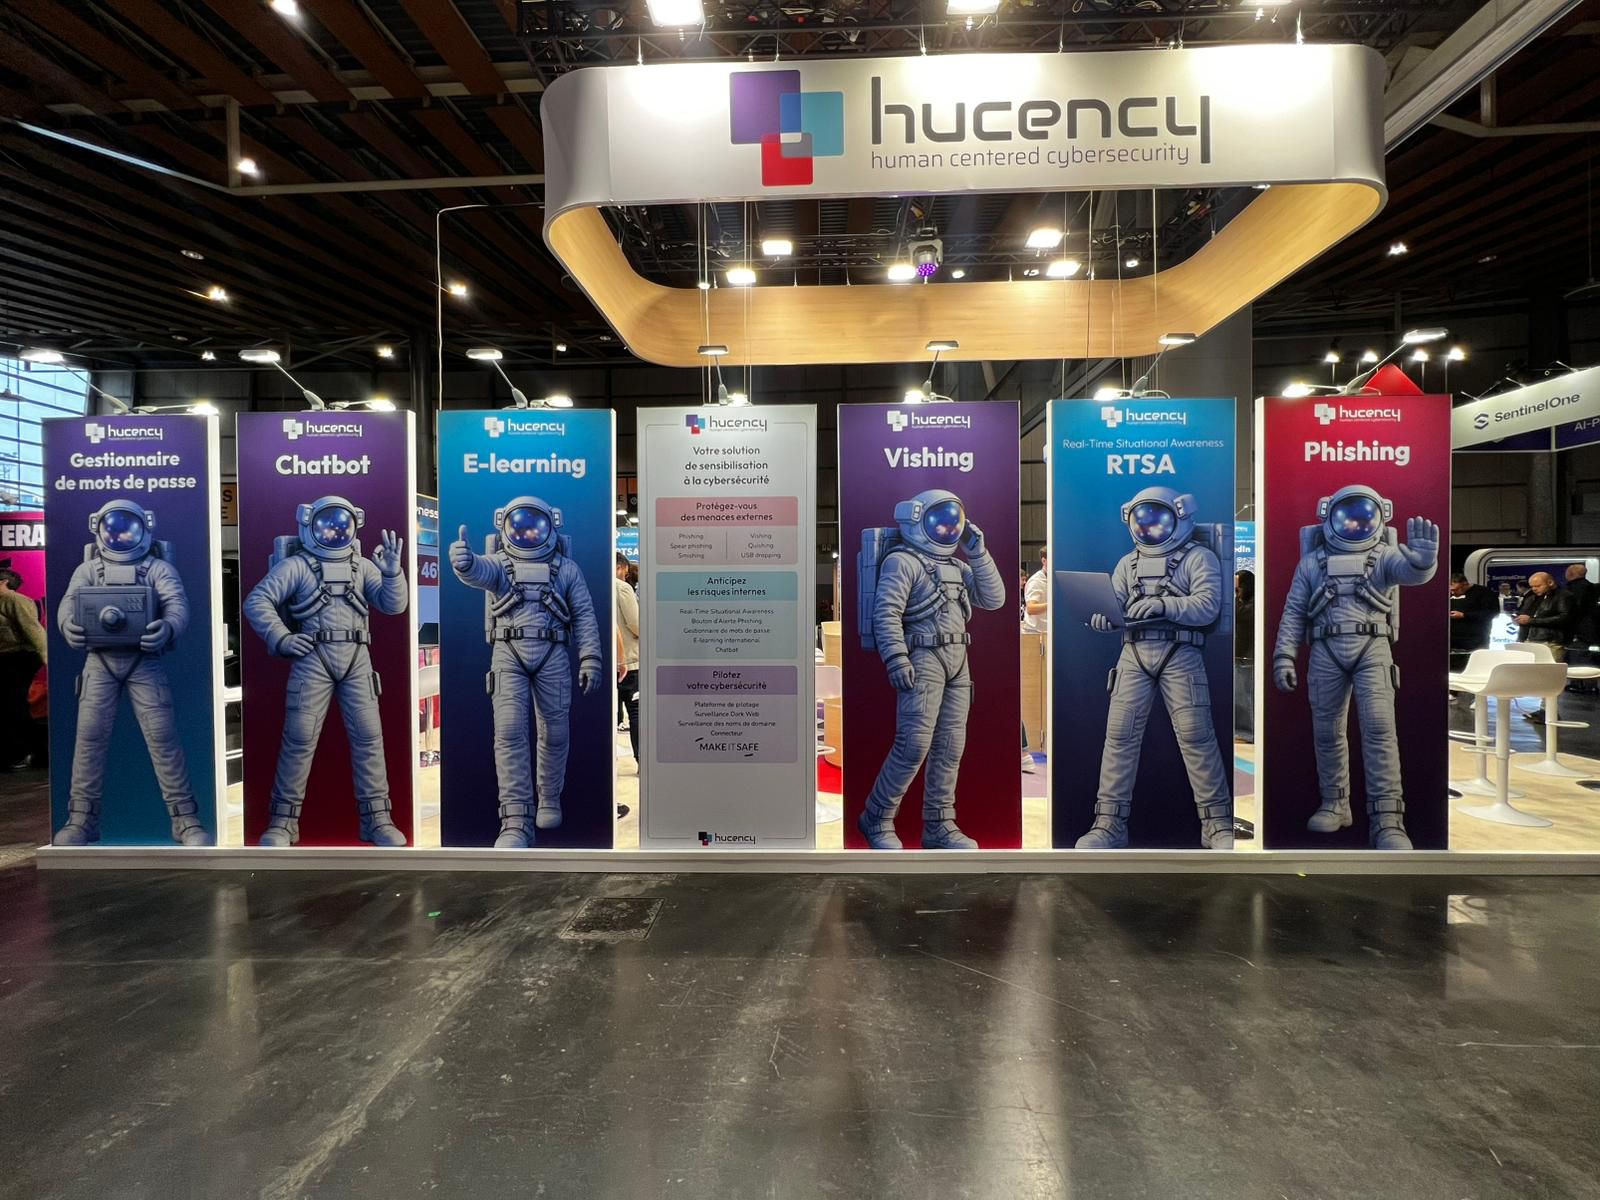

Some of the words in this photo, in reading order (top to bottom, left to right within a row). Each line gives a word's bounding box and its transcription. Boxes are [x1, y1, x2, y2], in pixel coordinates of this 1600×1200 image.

[871, 76, 1211, 165] hucency
[871, 150, 943, 169] human
[949, 147, 1040, 168] centered
[1046, 143, 1190, 168] cybersecurity
[1125, 407, 1187, 425] hucency
[1339, 404, 1401, 422] hucency
[1494, 393, 1581, 423] SentinelOne
[507, 418, 565, 436] hucency
[709, 415, 768, 432] hucency
[911, 411, 971, 429] hucency
[108, 424, 163, 441] hucency
[306, 420, 363, 438] hucency
[693, 446, 720, 456] Votre
[722, 445, 760, 455] solution
[1062, 438, 1114, 449] Real-Time
[1116, 437, 1169, 449] Situational
[1170, 438, 1224, 448] Awareness
[70, 451, 181, 468] Gestionnaire
[883, 446, 974, 473] Vishing
[1304, 439, 1411, 467] Phishing
[275, 454, 371, 475] Chatbot
[463, 452, 586, 479] E-learning
[685, 461, 698, 471] de
[699, 460, 768, 471] sensibilisation
[1106, 454, 1177, 475] RTSA
[55, 476, 76, 491] de
[79, 475, 121, 491] mots
[123, 474, 145, 489] de
[147, 475, 197, 493] passe
[684, 475, 691, 485] à
[692, 475, 702, 485] la
[703, 474, 770, 487] cybersécurité
[416, 506, 439, 519] ness
[696, 501, 757, 513] Protégez-vous
[680, 513, 696, 522] des
[697, 513, 735, 522] menaces
[736, 512, 773, 522] externes
[0, 524, 46, 547] ERA
[678, 532, 704, 541] Phishing
[750, 532, 772, 541] Vishing
[670, 542, 687, 551] Spear
[707, 576, 747, 587] Anticipez
[687, 587, 700, 597] les
[700, 587, 731, 599] risques
[731, 587, 766, 597] internes
[712, 670, 742, 680] Pilotez
[687, 682, 710, 691] votre
[710, 681, 768, 693] cybersécurité
[699, 742, 727, 752] MAKE
[736, 742, 760, 752] SAFE
[714, 832, 756, 845] hucency
